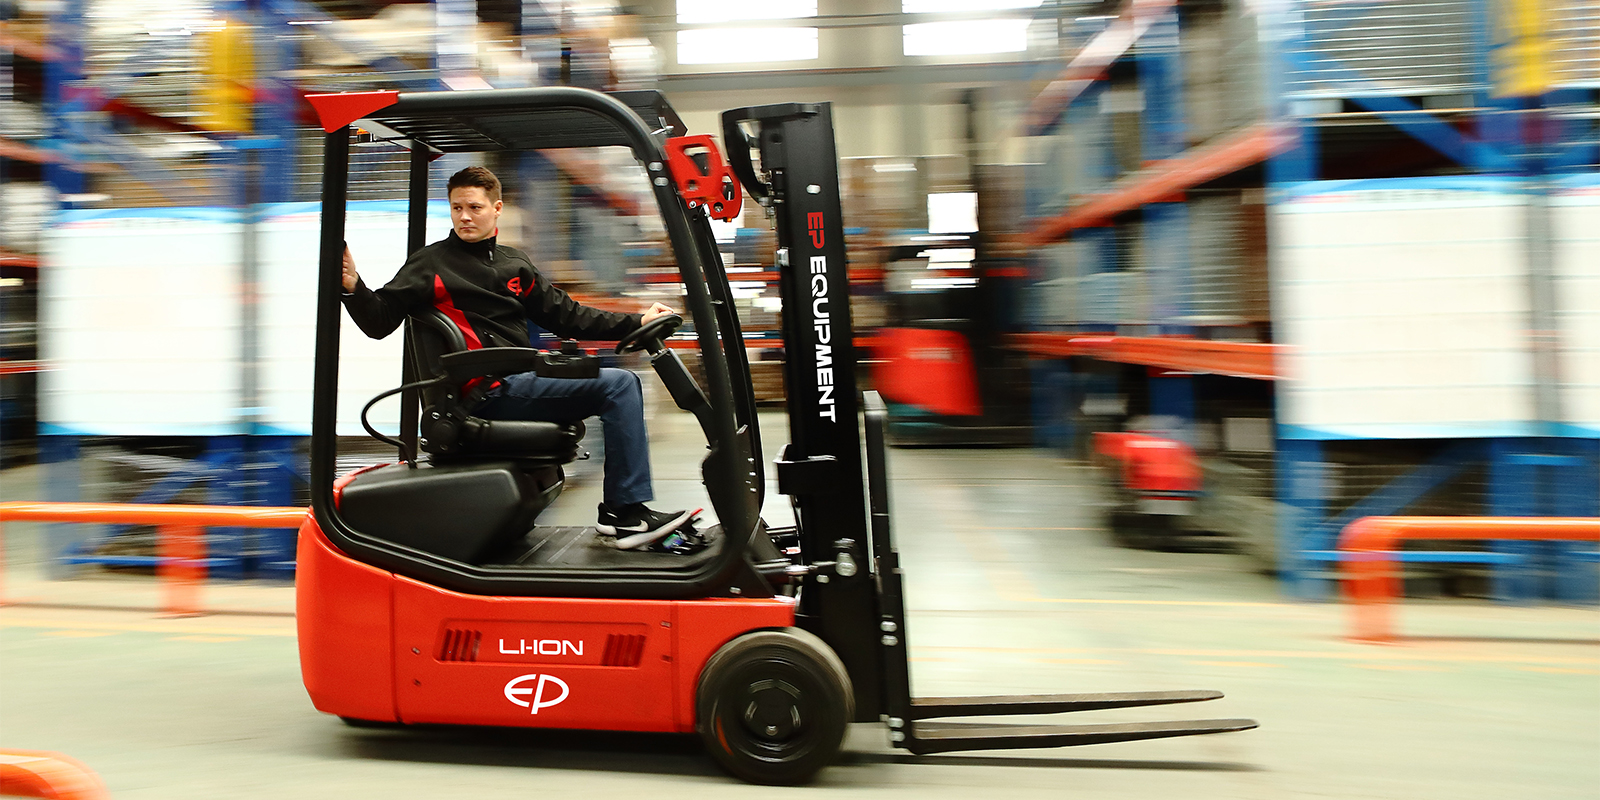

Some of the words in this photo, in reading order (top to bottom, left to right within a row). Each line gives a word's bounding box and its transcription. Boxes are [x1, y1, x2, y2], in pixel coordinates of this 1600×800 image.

[807, 211, 825, 249] EP
[810, 256, 836, 423] EQUIPMENT
[499, 638, 584, 656] LI-ION
[503, 673, 570, 714] EP
